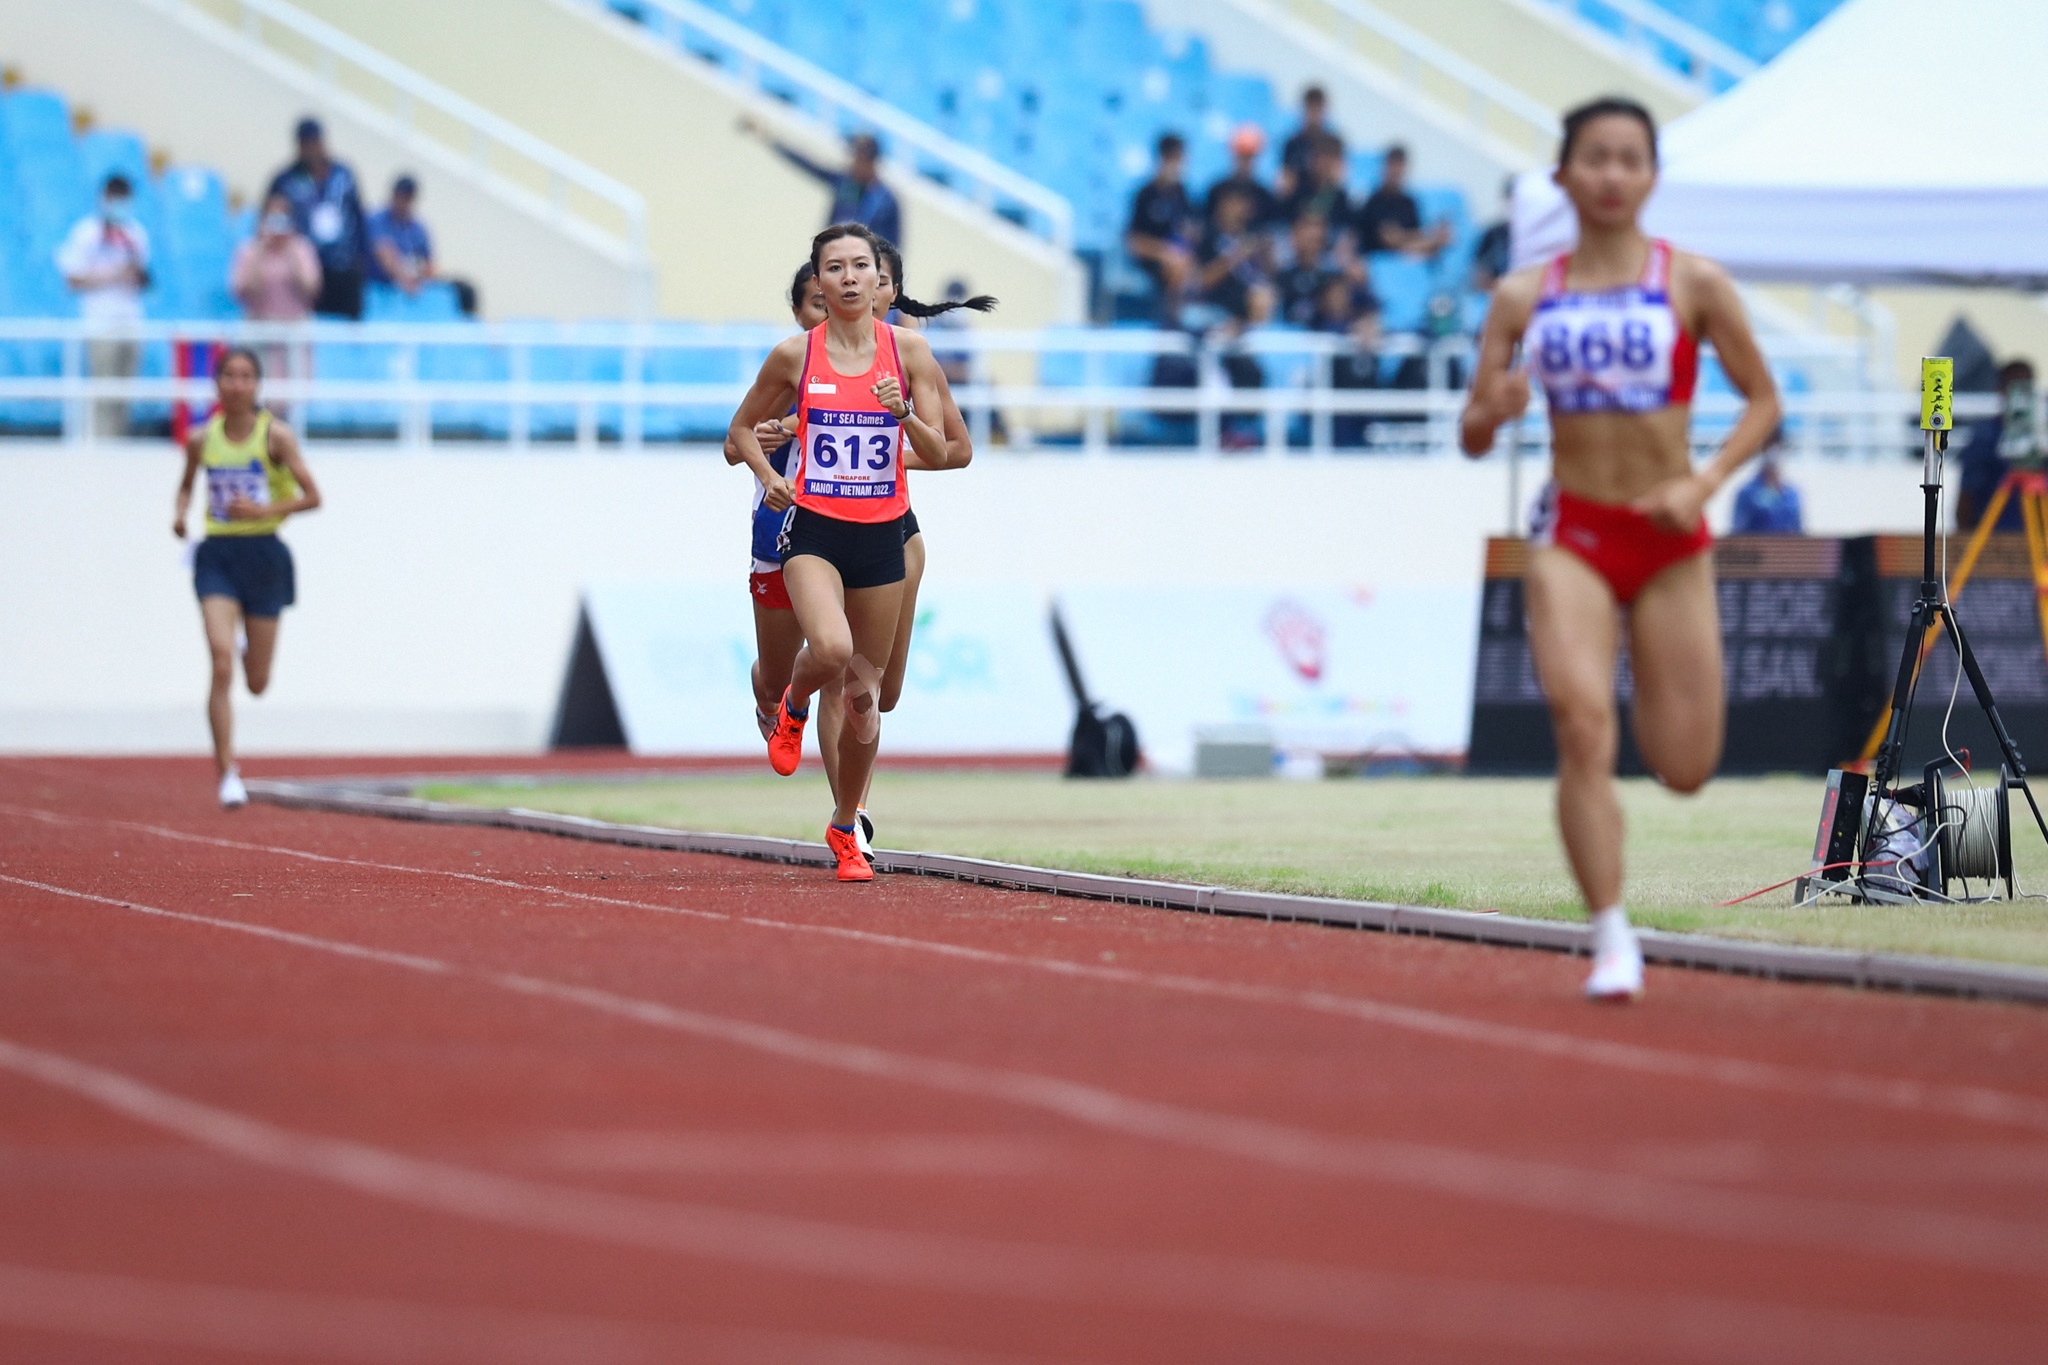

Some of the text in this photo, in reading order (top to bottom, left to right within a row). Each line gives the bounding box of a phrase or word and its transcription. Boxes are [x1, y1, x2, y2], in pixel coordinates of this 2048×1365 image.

[1541, 320, 1655, 373] 868
[838, 413, 855, 425] SEA
[856, 414, 885, 425] Games
[813, 432, 891, 470] 613
[810, 481, 834, 495] HANOI
[840, 484, 872, 496] VIETNAM
[872, 484, 889, 496] 2022
